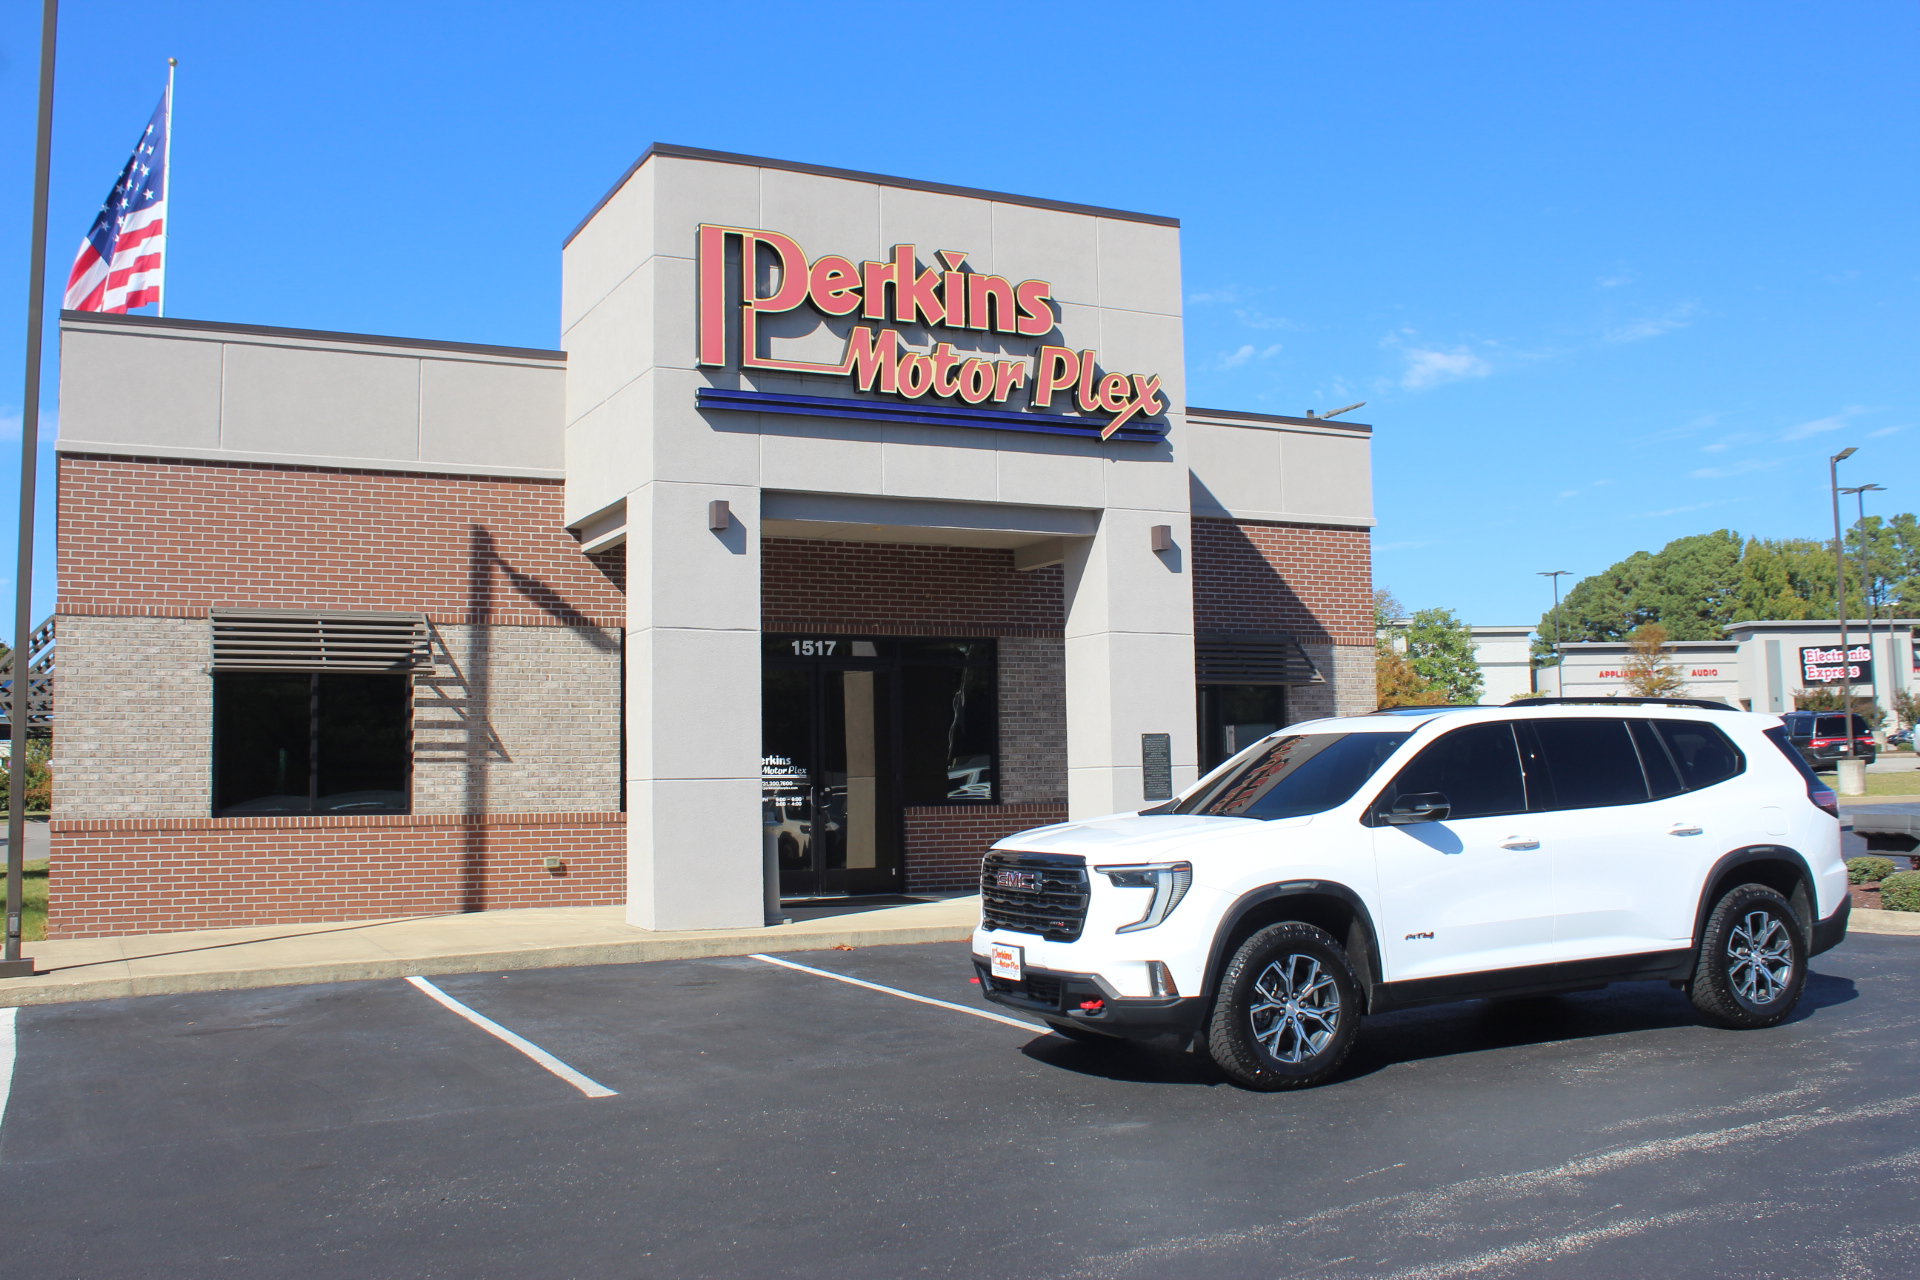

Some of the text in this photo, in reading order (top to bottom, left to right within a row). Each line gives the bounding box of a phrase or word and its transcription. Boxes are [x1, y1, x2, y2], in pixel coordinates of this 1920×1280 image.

[698, 223, 1056, 374] Perkins
[846, 326, 1163, 441] Motor Plex
[791, 640, 837, 656] 1517
[1804, 646, 1871, 664] Electrnic
[1691, 669, 1718, 677] AUDIO
[1807, 665, 1860, 682] Expres
[761, 755, 791, 766] erkins
[788, 765, 807, 775] Plex
[997, 871, 1035, 889] GMC
[1404, 931, 1434, 940] AT4
